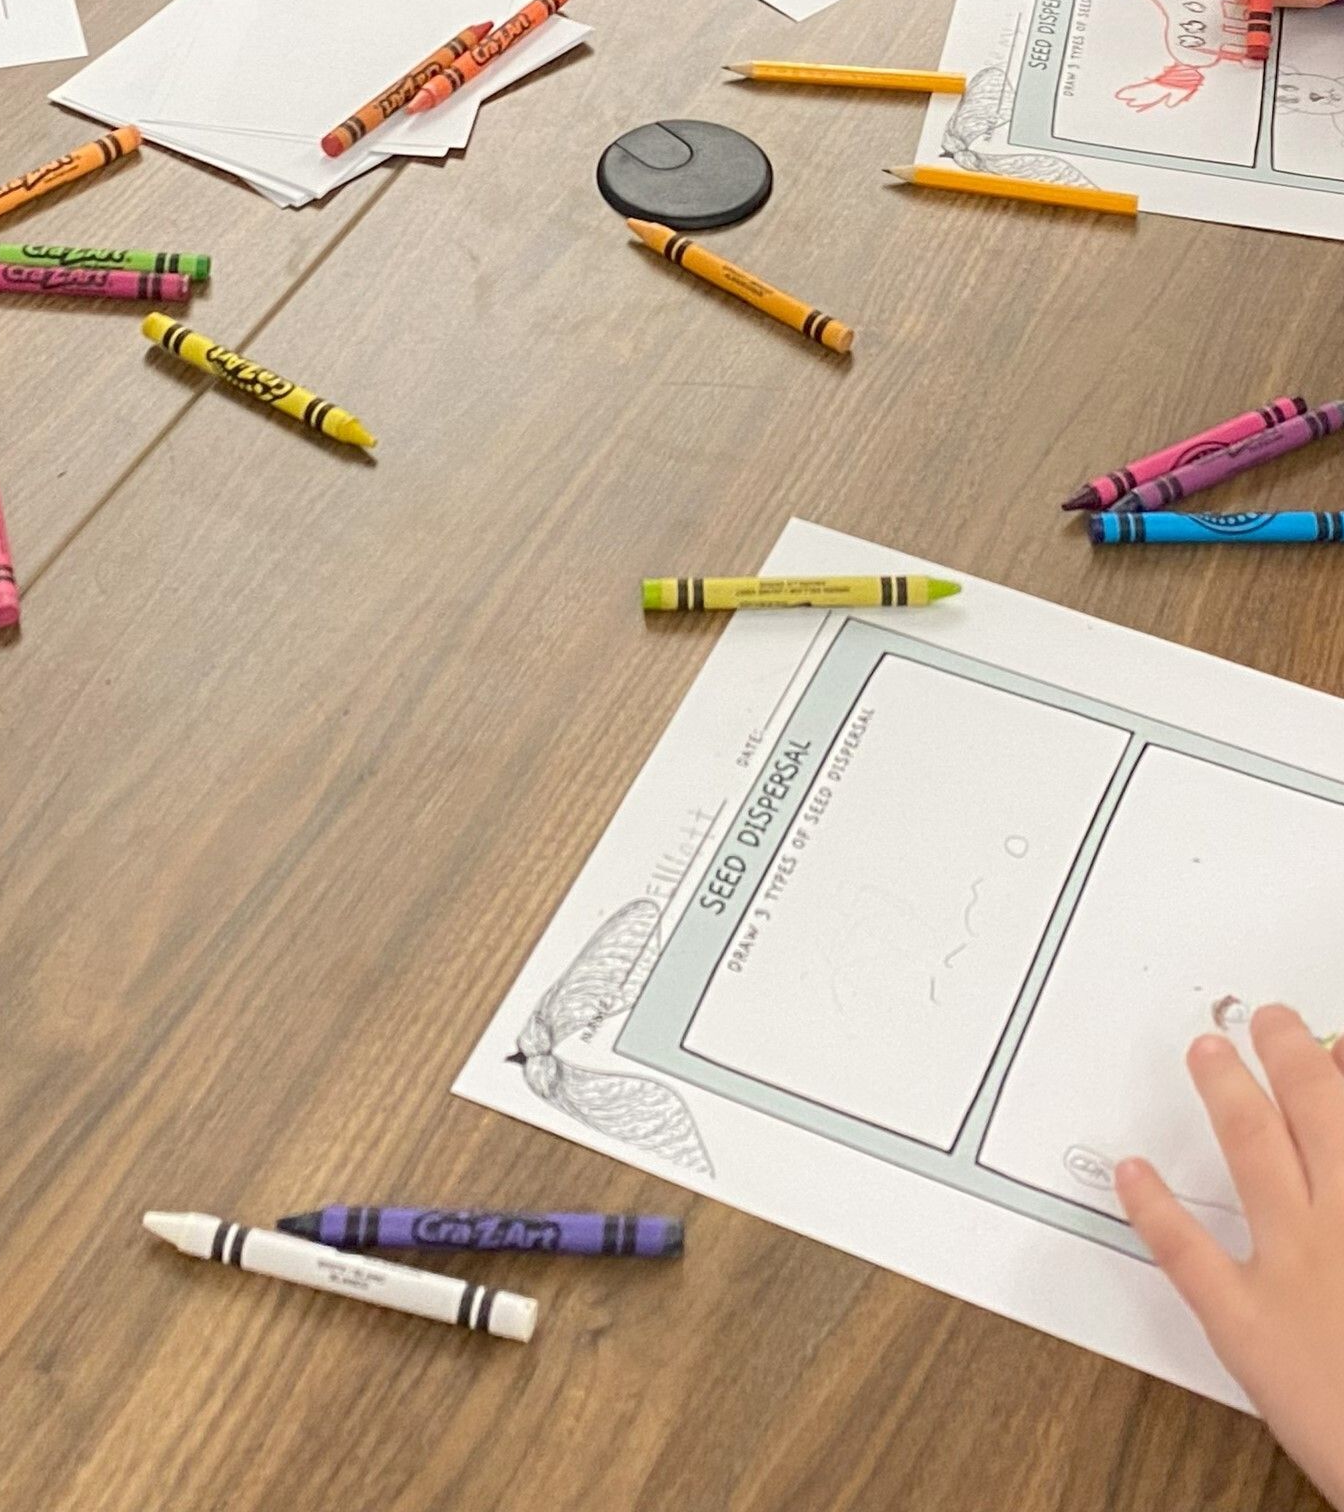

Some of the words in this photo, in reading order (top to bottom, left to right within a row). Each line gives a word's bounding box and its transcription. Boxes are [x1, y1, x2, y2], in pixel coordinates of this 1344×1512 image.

[1075, 18, 1087, 32] OF
[1028, 38, 1052, 71] SEED
[1070, 31, 1086, 61] TYPES
[1062, 71, 1076, 97] DRAW
[699, 854, 747, 916] SEED
[736, 738, 812, 849] DISPERSAL
[726, 927, 762, 974] DRAW
[754, 906, 771, 922] 3
[765, 855, 798, 909] TYPES
[792, 829, 812, 851] OF
[802, 784, 834, 827] SEED
[827, 706, 876, 782] DISPERSAL
